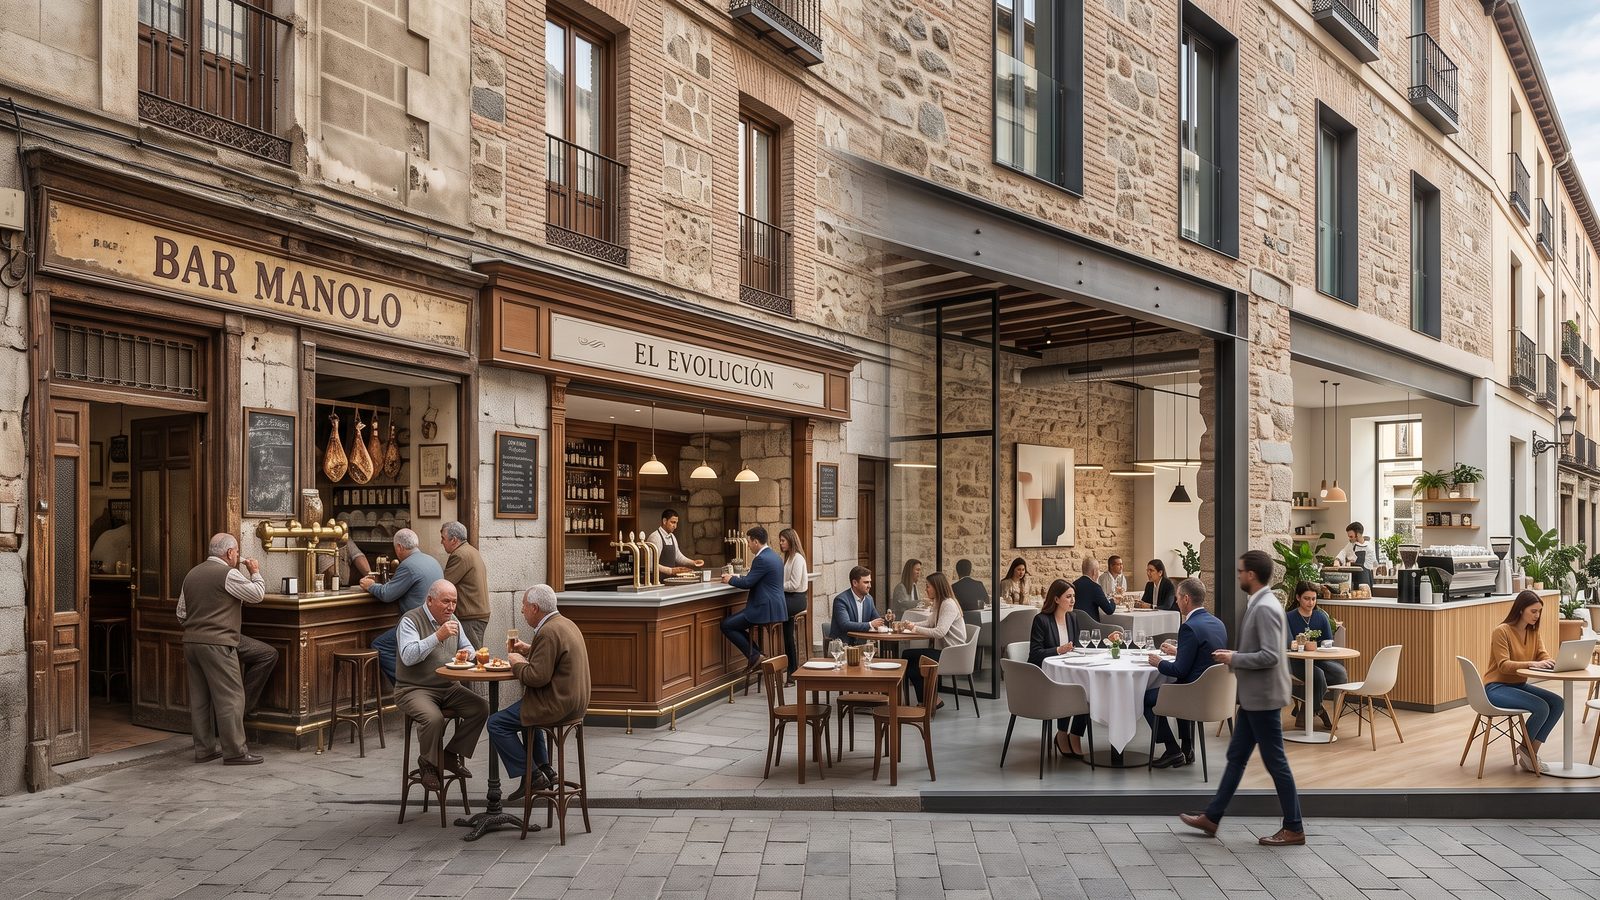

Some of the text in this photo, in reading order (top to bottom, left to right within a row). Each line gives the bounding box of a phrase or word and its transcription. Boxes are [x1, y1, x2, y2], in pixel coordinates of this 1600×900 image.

[153, 236, 402, 328] BAR MANOLO
[635, 343, 774, 390] EL EVOLUCIÓN
